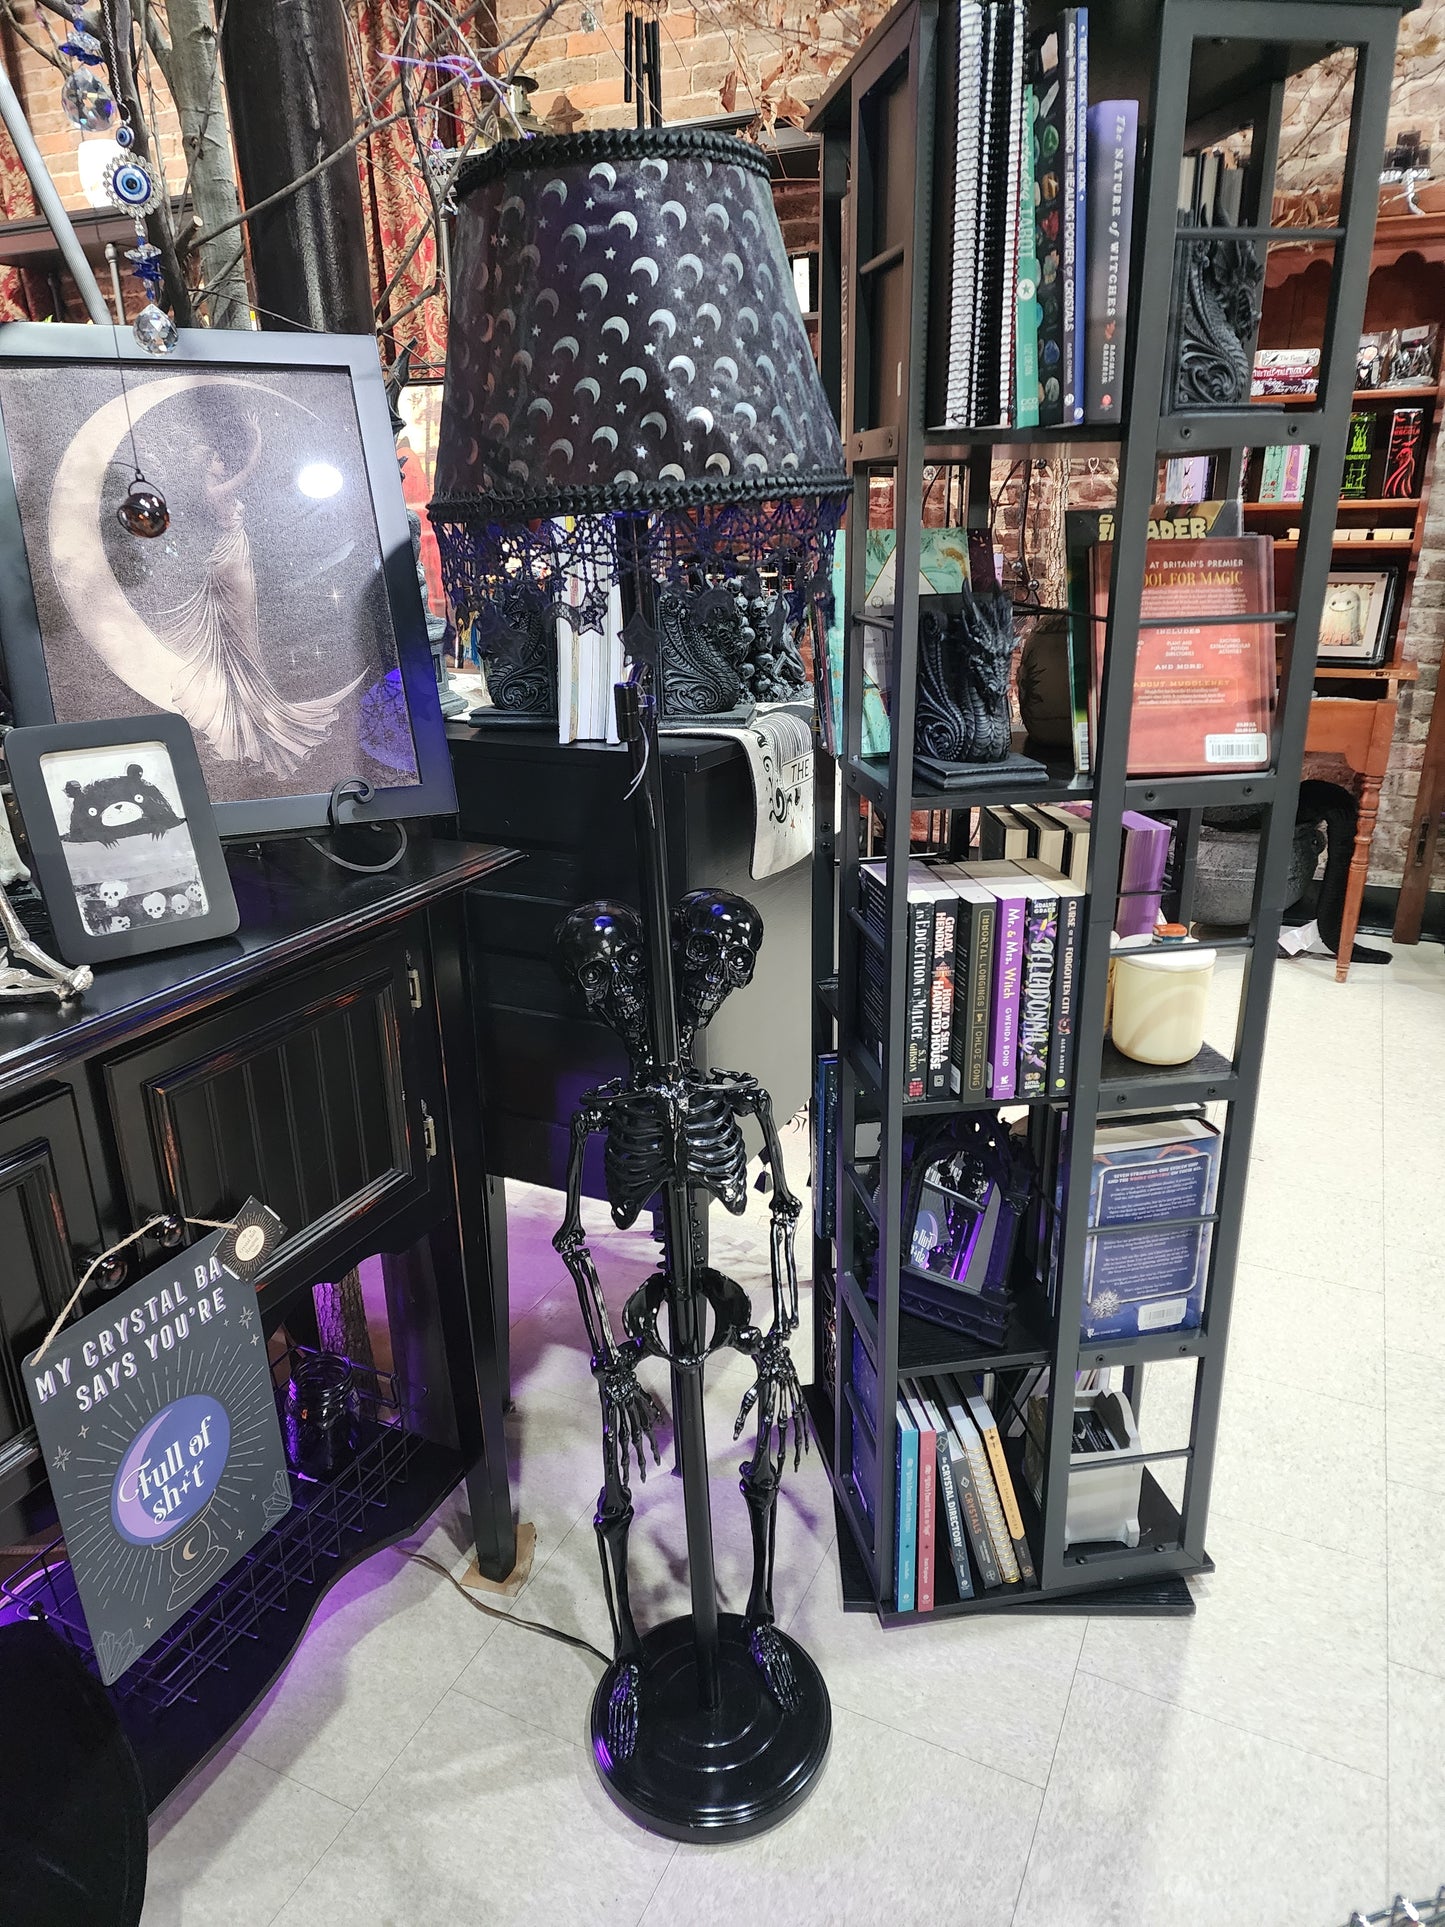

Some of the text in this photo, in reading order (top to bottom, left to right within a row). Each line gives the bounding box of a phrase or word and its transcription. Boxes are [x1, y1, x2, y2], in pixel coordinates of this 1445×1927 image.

[1080, 36, 1088, 60] THE
[1079, 61, 1087, 103] MAGICK
[1065, 80, 1075, 153] HARNESSING
[1065, 172, 1075, 220] HEALING
[1078, 162, 1086, 191] BOOK
[1018, 206, 1034, 258] TAROT
[1107, 115, 1125, 317] The NATURE of WITCHES
[1064, 221, 1075, 265] POWER
[1064, 279, 1074, 332] CRYSTALS
[1150, 559, 1244, 569] AT BRITAIN'S PREMIER
[1170, 572, 1196, 587] FOR
[1200, 571, 1243, 586] MAGIC
[791, 758, 810, 783] THE
[934, 912, 947, 959] HENDRIX
[945, 916, 955, 953] GRADY
[1067, 901, 1076, 928] CURSE
[913, 920, 930, 985] EDUCATION
[1003, 908, 1021, 999] Mr. & Mrs. Witch
[1062, 947, 1074, 995] FORGOTTEN
[977, 963, 986, 1007] LONGINGS
[1025, 938, 1054, 1046] BELLADONNA
[1061, 997, 1070, 1015] CITY
[909, 999, 927, 1041] MALICE
[930, 981, 943, 1070] HAUNTED HOUSE
[940, 988, 952, 1063] HOW TO SELL A
[1003, 1007, 1012, 1067] GWENDA BOND
[909, 1043, 917, 1072] GIBSON
[972, 1063, 981, 1086] GONG
[35, 1256, 224, 1404] MY CRYSTAL BA
[76, 1287, 226, 1412] SAYS YOU'RE
[120, 1415, 212, 1502] Full of
[941, 1464, 955, 1500] CRYSTAL
[947, 1501, 963, 1548] DIRECTORY
[964, 1492, 982, 1535] CRYSTALS
